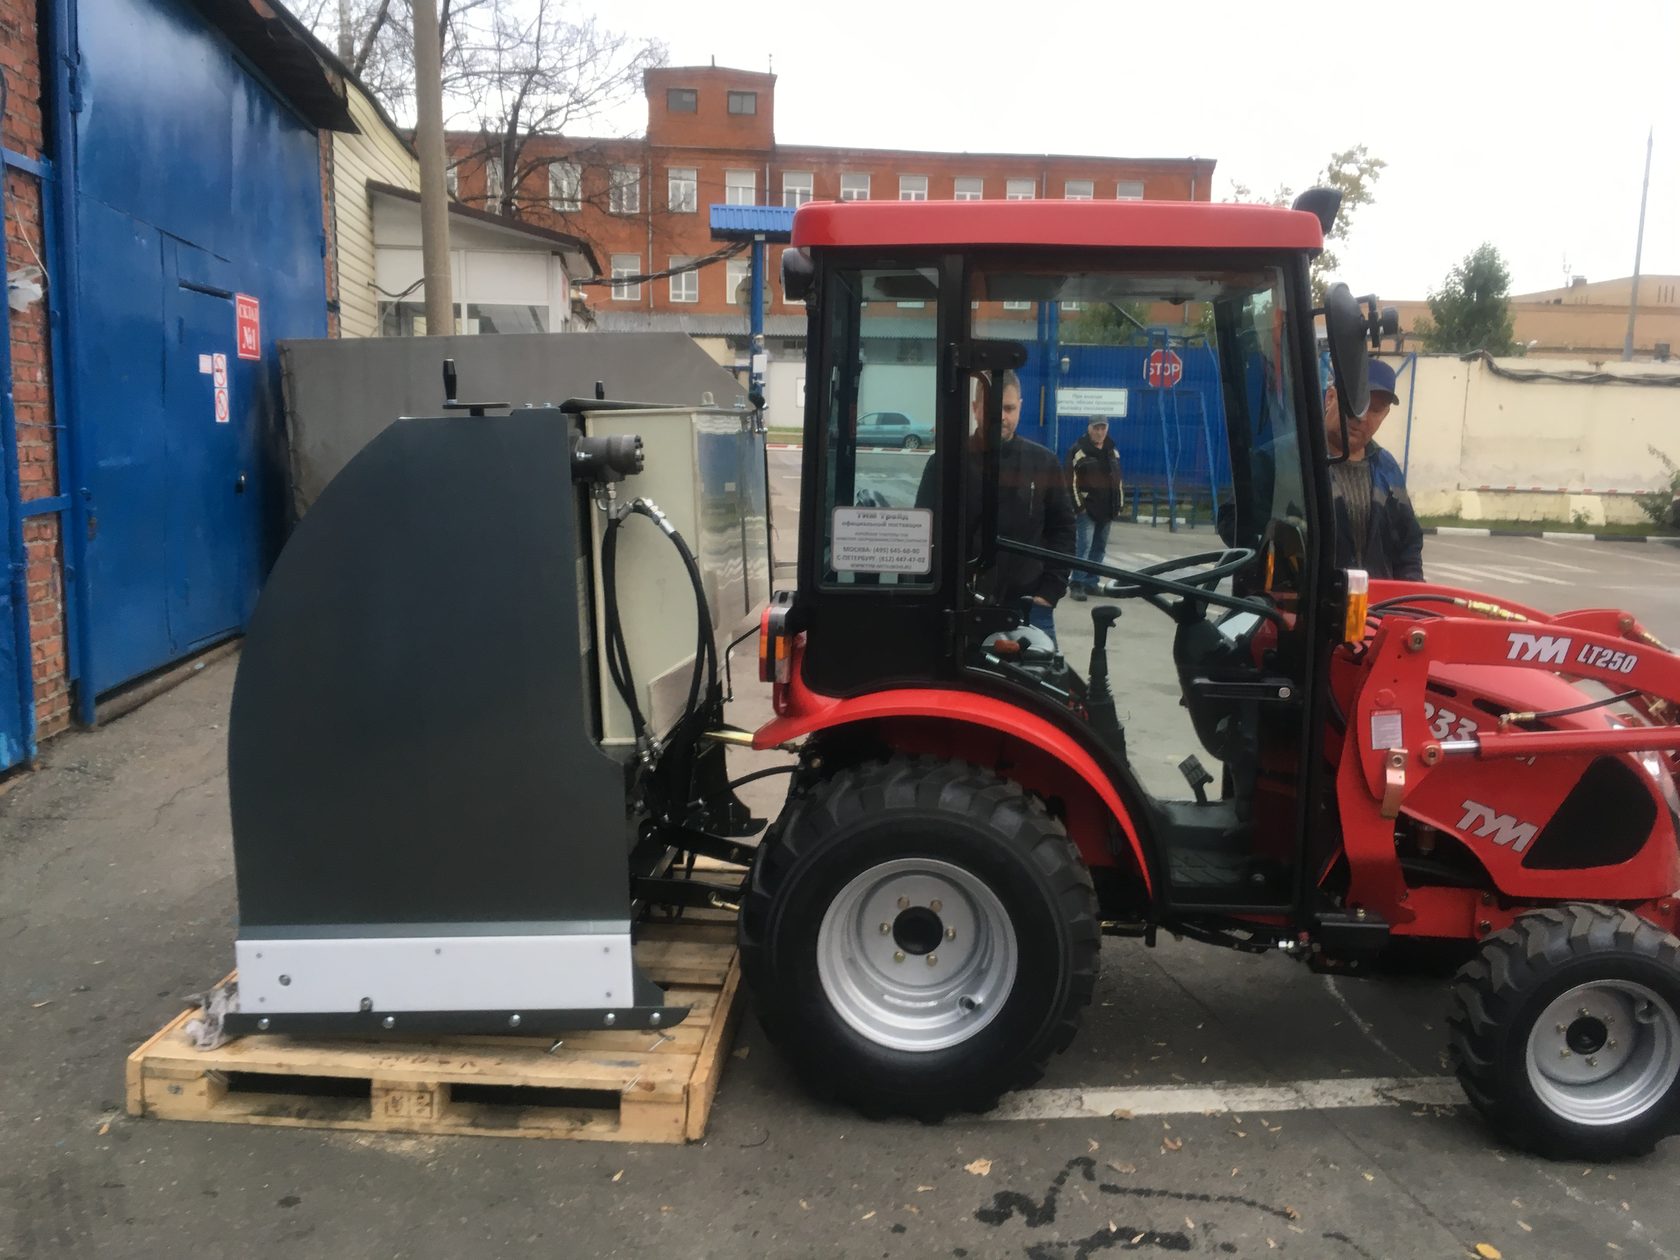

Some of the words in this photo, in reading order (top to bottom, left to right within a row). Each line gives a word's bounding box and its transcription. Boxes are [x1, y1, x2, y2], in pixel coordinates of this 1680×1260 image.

[1149, 362, 1180, 376] STOP
[1506, 632, 1572, 664] TYM
[1577, 643, 1638, 673] LT250
[1455, 800, 1539, 853] TYM
